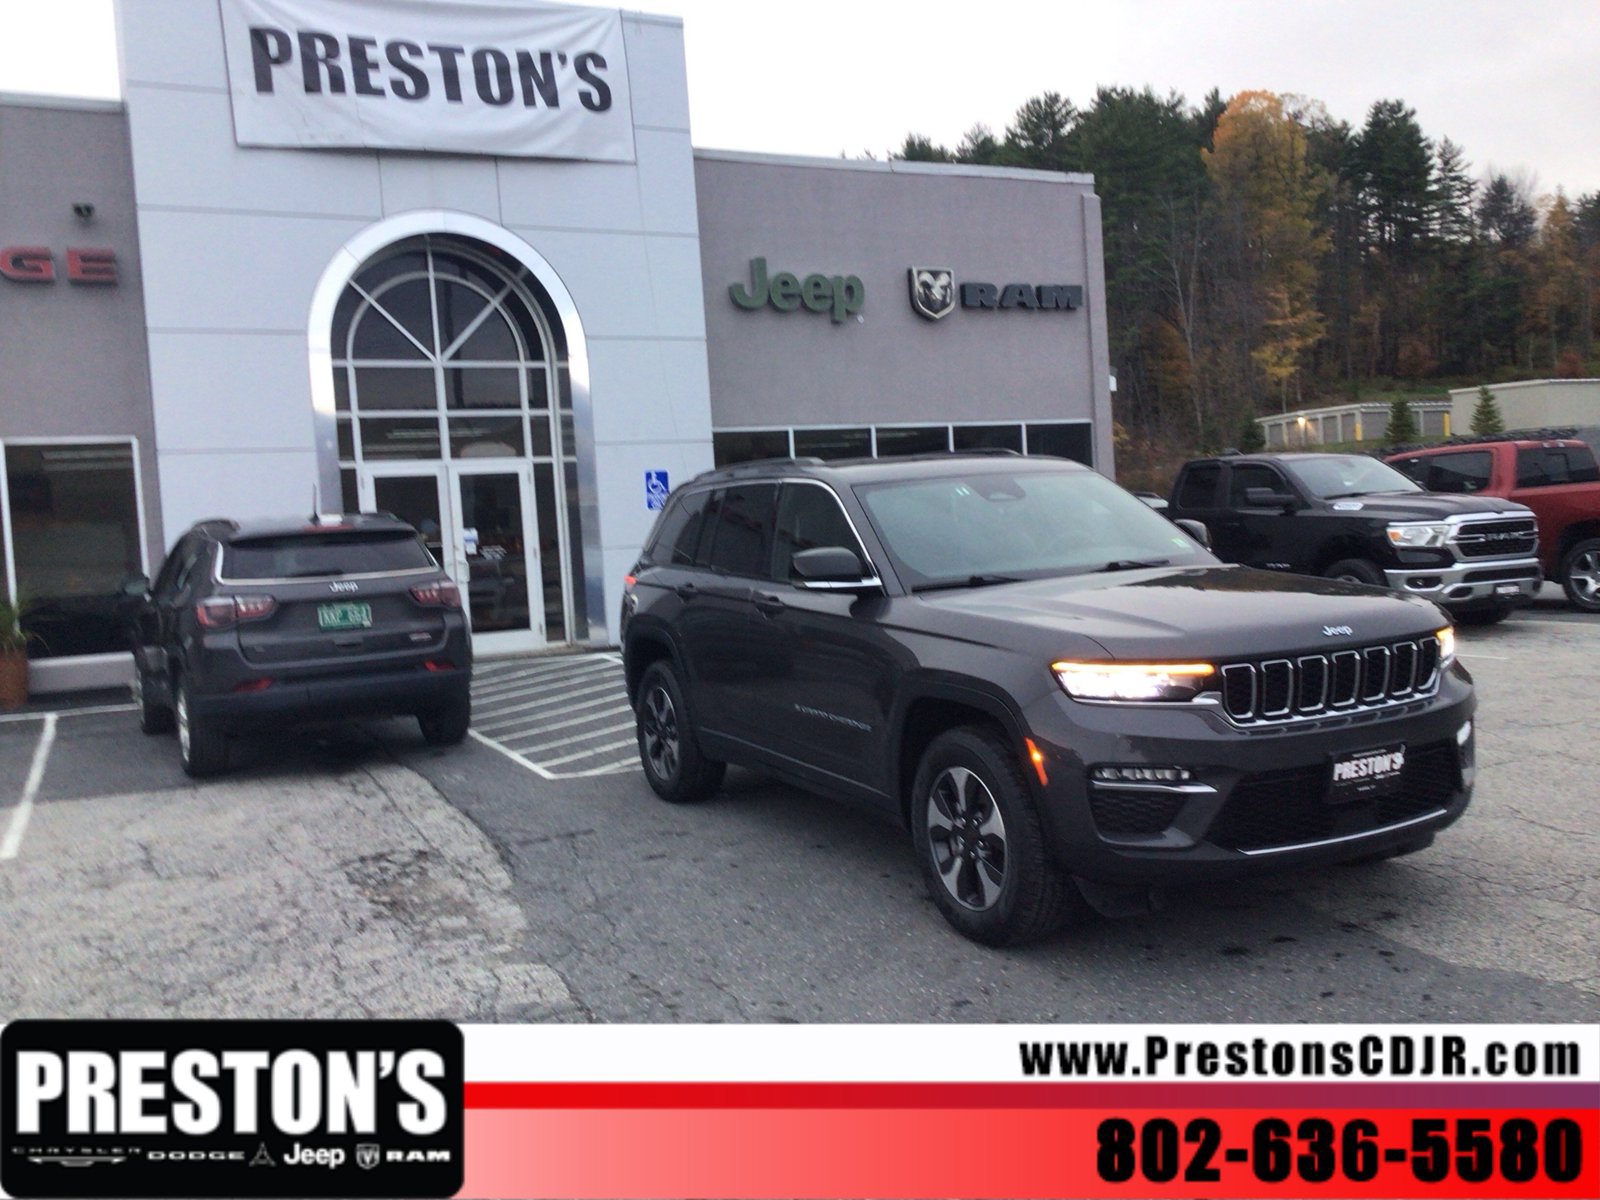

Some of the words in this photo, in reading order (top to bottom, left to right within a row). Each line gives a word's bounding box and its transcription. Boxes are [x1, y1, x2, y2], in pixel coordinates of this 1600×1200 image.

[250, 27, 612, 112] PRESTON'S
[729, 256, 865, 324] Jeep
[961, 282, 1082, 311] RAM
[329, 580, 359, 593] Jeep
[1322, 625, 1353, 637] Jeep
[1332, 752, 1405, 781] PRESTON'S
